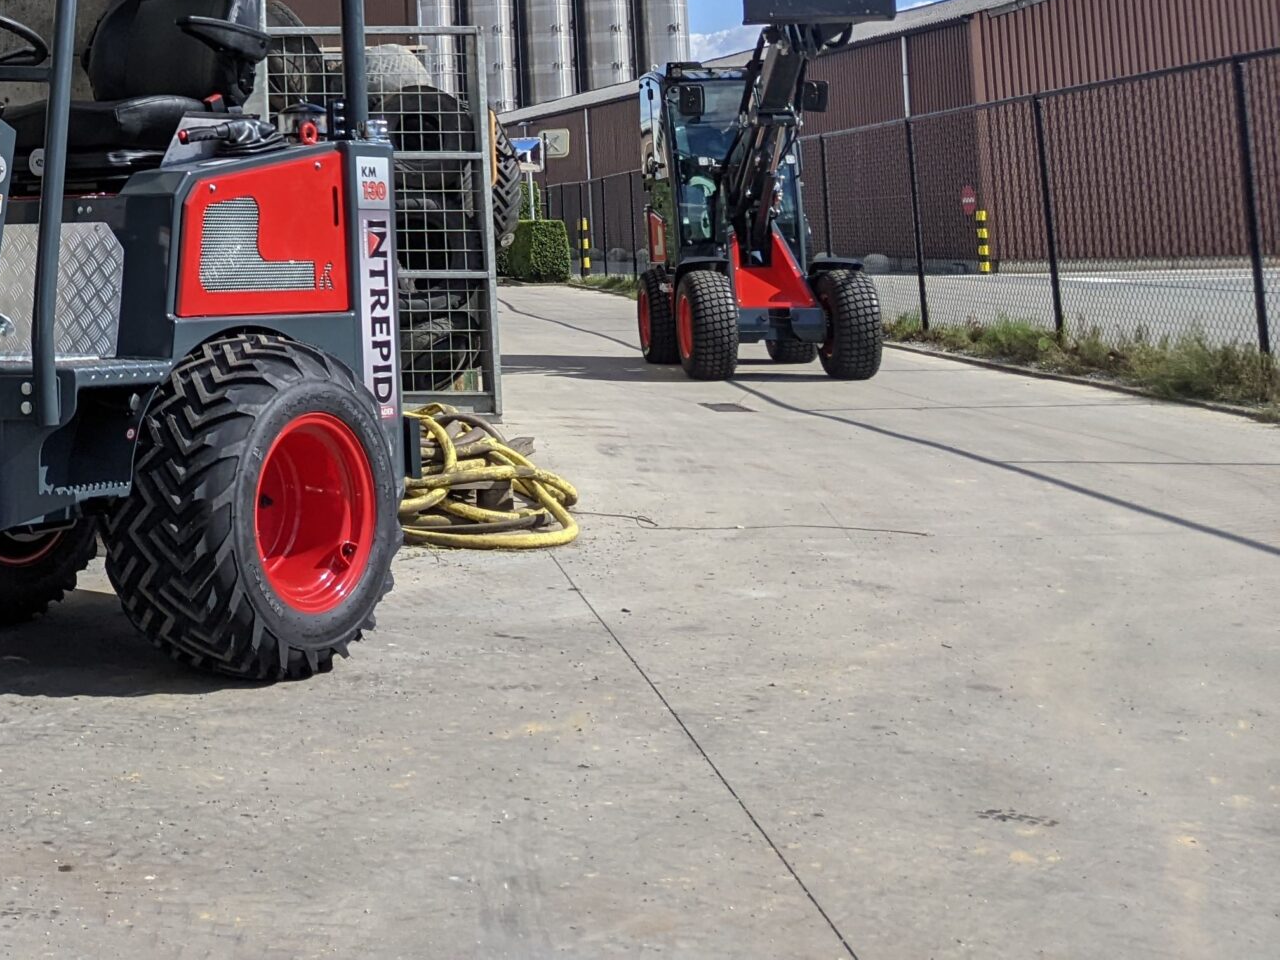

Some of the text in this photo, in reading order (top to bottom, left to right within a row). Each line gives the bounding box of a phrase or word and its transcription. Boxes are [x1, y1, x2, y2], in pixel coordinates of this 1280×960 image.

[361, 167, 377, 178] KM
[362, 181, 386, 200] 130
[368, 220, 392, 403] INTREPID
